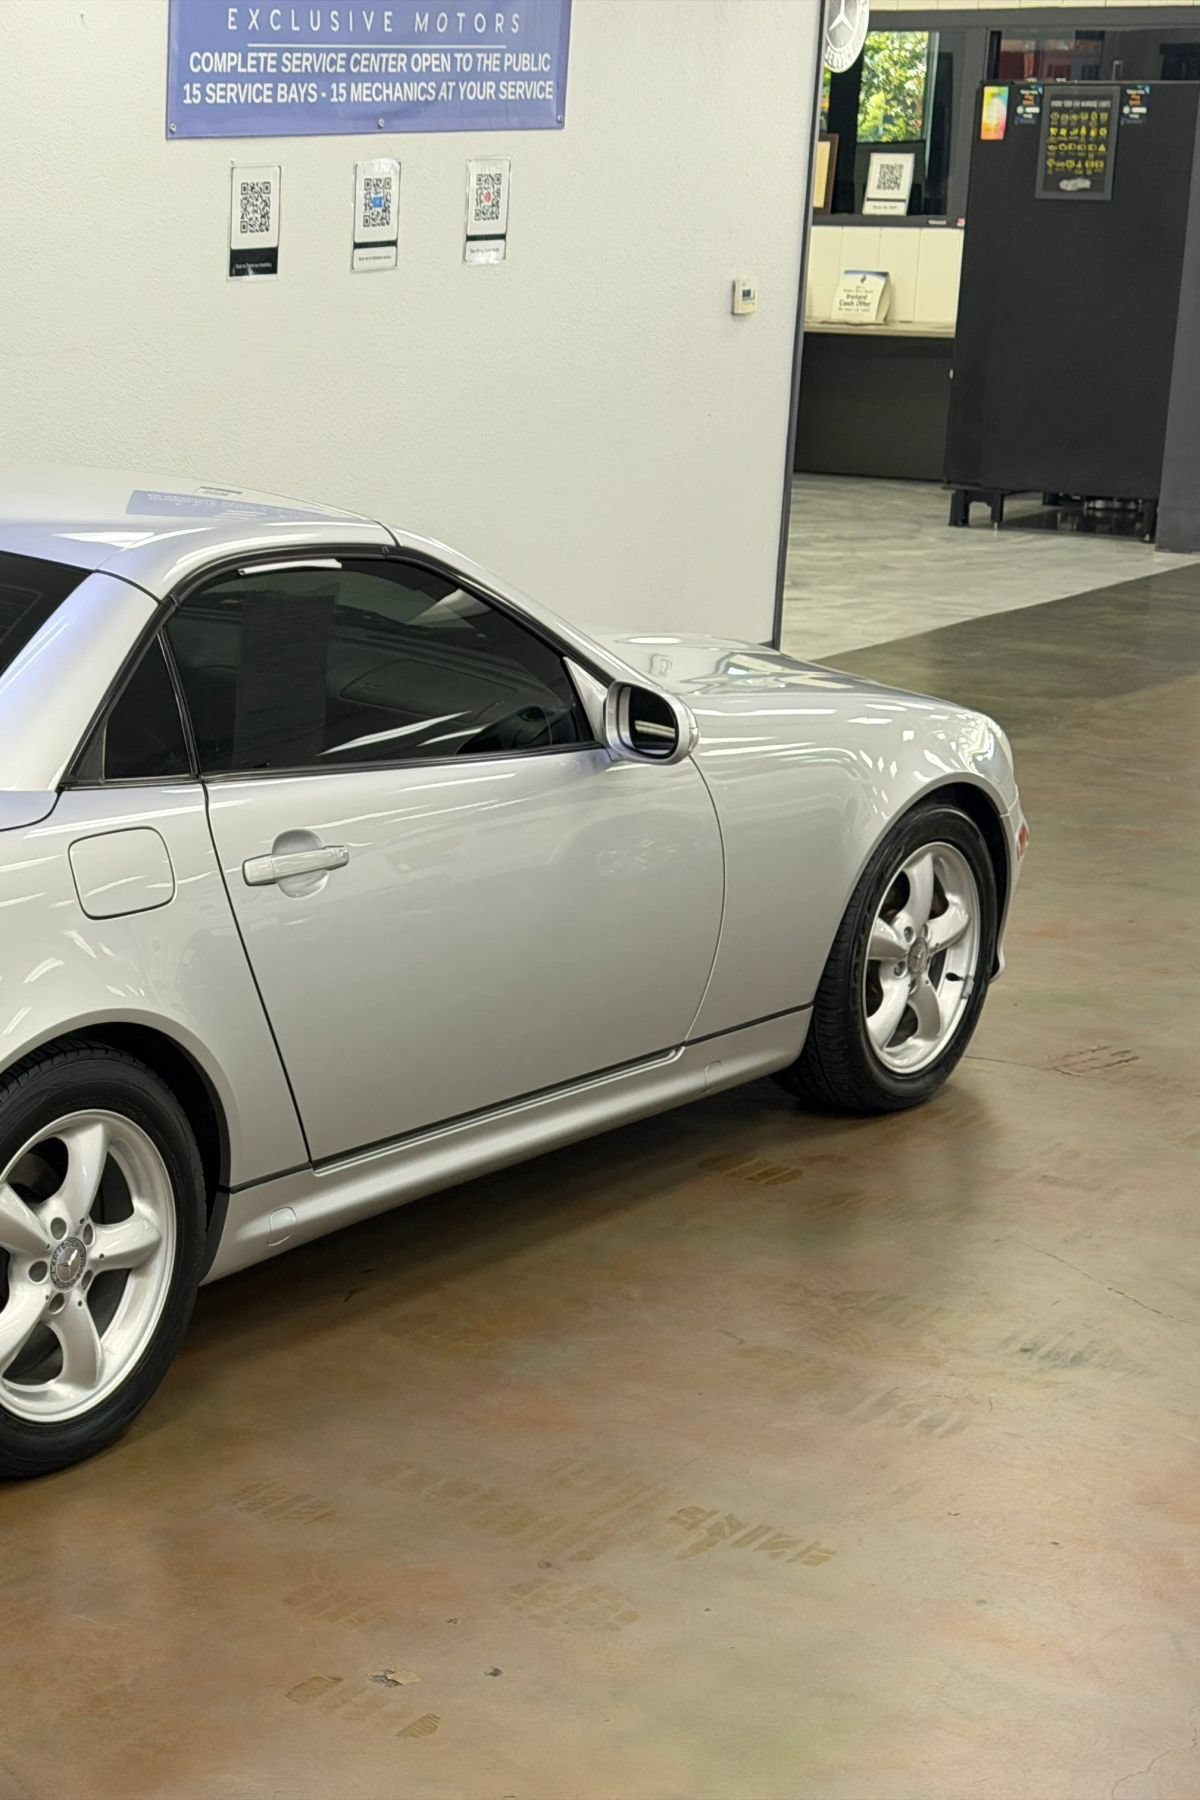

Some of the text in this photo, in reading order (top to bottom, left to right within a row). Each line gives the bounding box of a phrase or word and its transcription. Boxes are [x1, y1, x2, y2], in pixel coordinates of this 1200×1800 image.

[228, 8, 520, 33] EXCLUSIVE MOTORS
[189, 52, 551, 73] COMPLETE SERVICE CENTER OPEN TO THE PUBLIC
[183, 83, 201, 104] 15
[205, 83, 273, 104] SERVICE
[277, 83, 318, 103] BAYS
[330, 82, 347, 102] 15
[350, 81, 436, 102] MECHANICS
[438, 81, 456, 101] AT
[459, 81, 495, 101] YOUR
[498, 80, 554, 100] SERVICE
